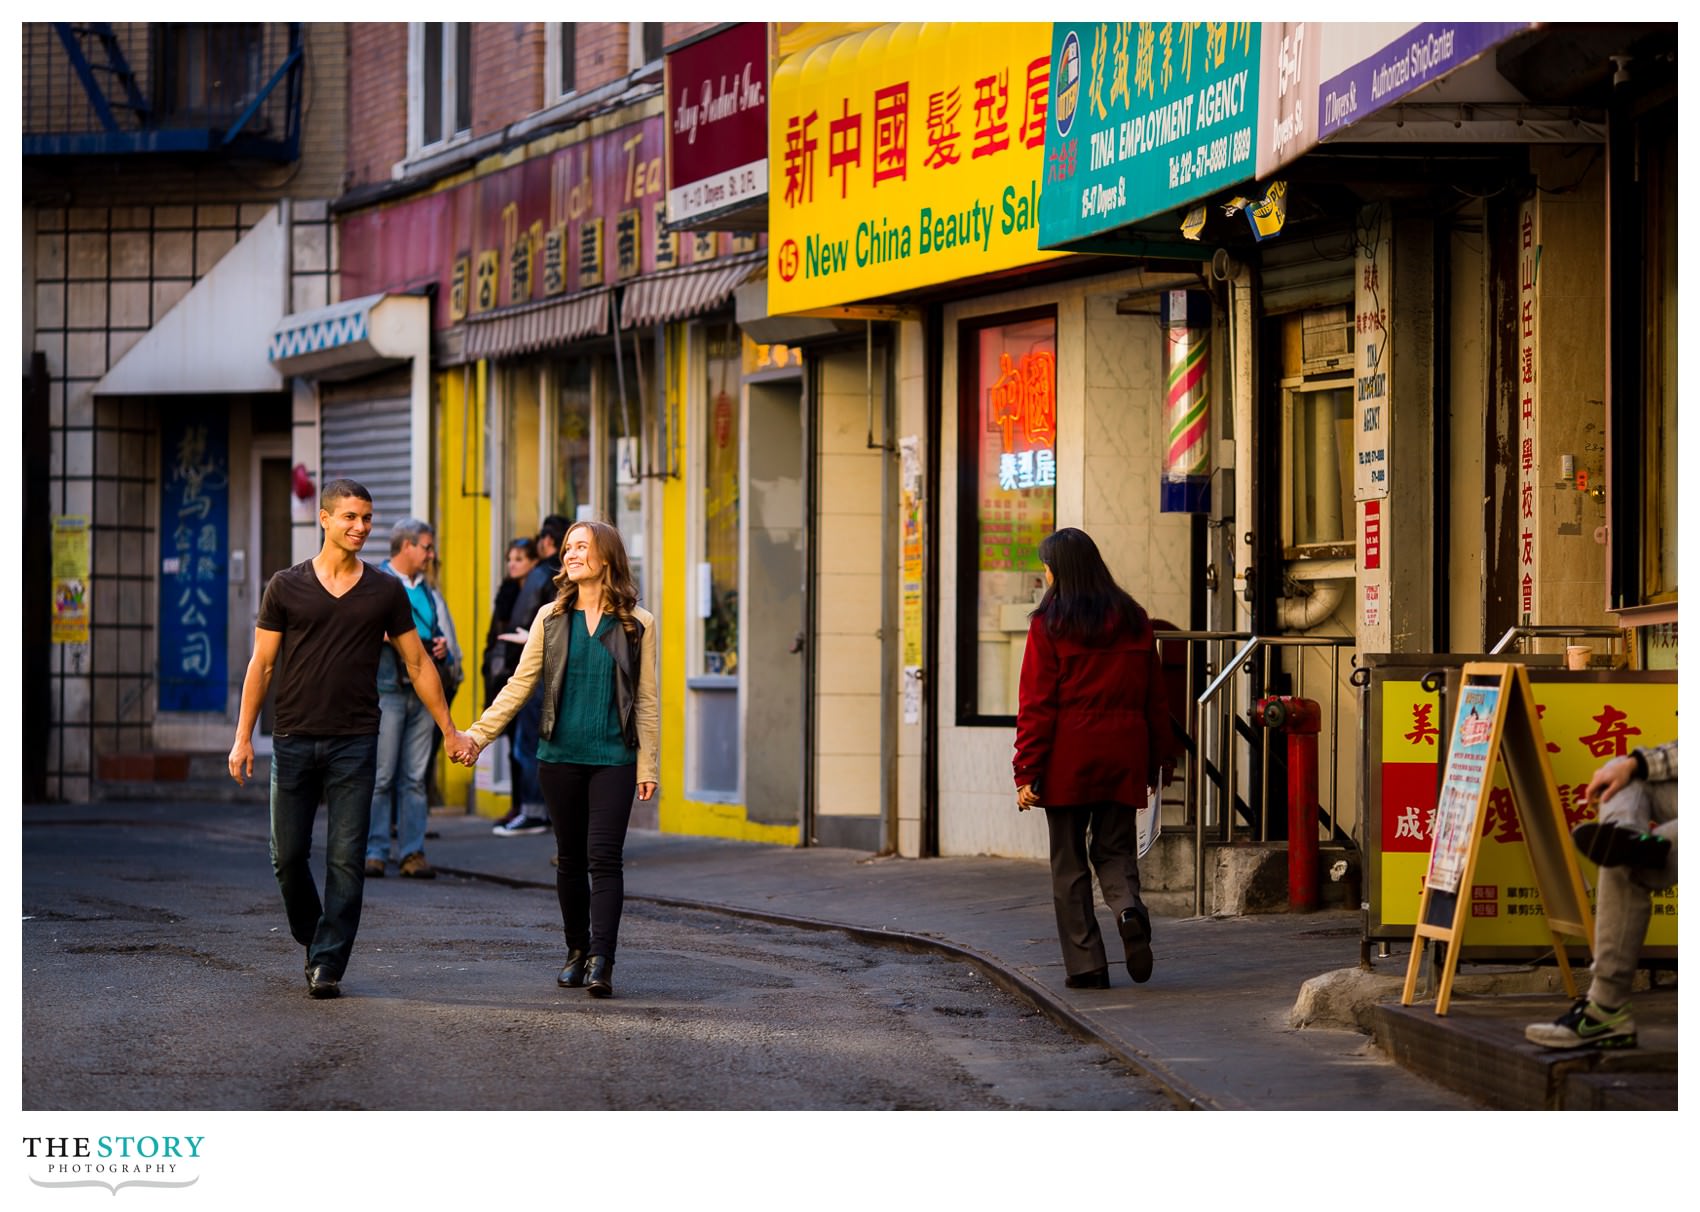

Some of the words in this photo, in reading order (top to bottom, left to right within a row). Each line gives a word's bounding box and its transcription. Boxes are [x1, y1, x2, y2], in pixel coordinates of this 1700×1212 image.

[739, 62, 765, 112] Inc.
[1371, 48, 1412, 102] Authorized
[1411, 29, 1455, 78] ShipCenter
[1090, 127, 1115, 172] TINA
[1119, 94, 1194, 161] EMPLOYMENT
[1196, 69, 1249, 131] AGENCY
[1331, 91, 1350, 127] Doyers
[1349, 81, 1358, 113] St.
[1233, 126, 1251, 165] 8889
[1273, 113, 1294, 155] Doyers
[1096, 183, 1118, 218] Doyers
[805, 235, 849, 279] New
[856, 217, 912, 268] China
[919, 198, 994, 252] Beauty
[1001, 180, 1042, 235] Sal
[780, 242, 798, 279] 15
[1366, 343, 1379, 369] TINA
[991, 352, 1056, 451] 中國
[1363, 406, 1381, 432] AGENCY
[1404, 703, 1441, 746] 美
